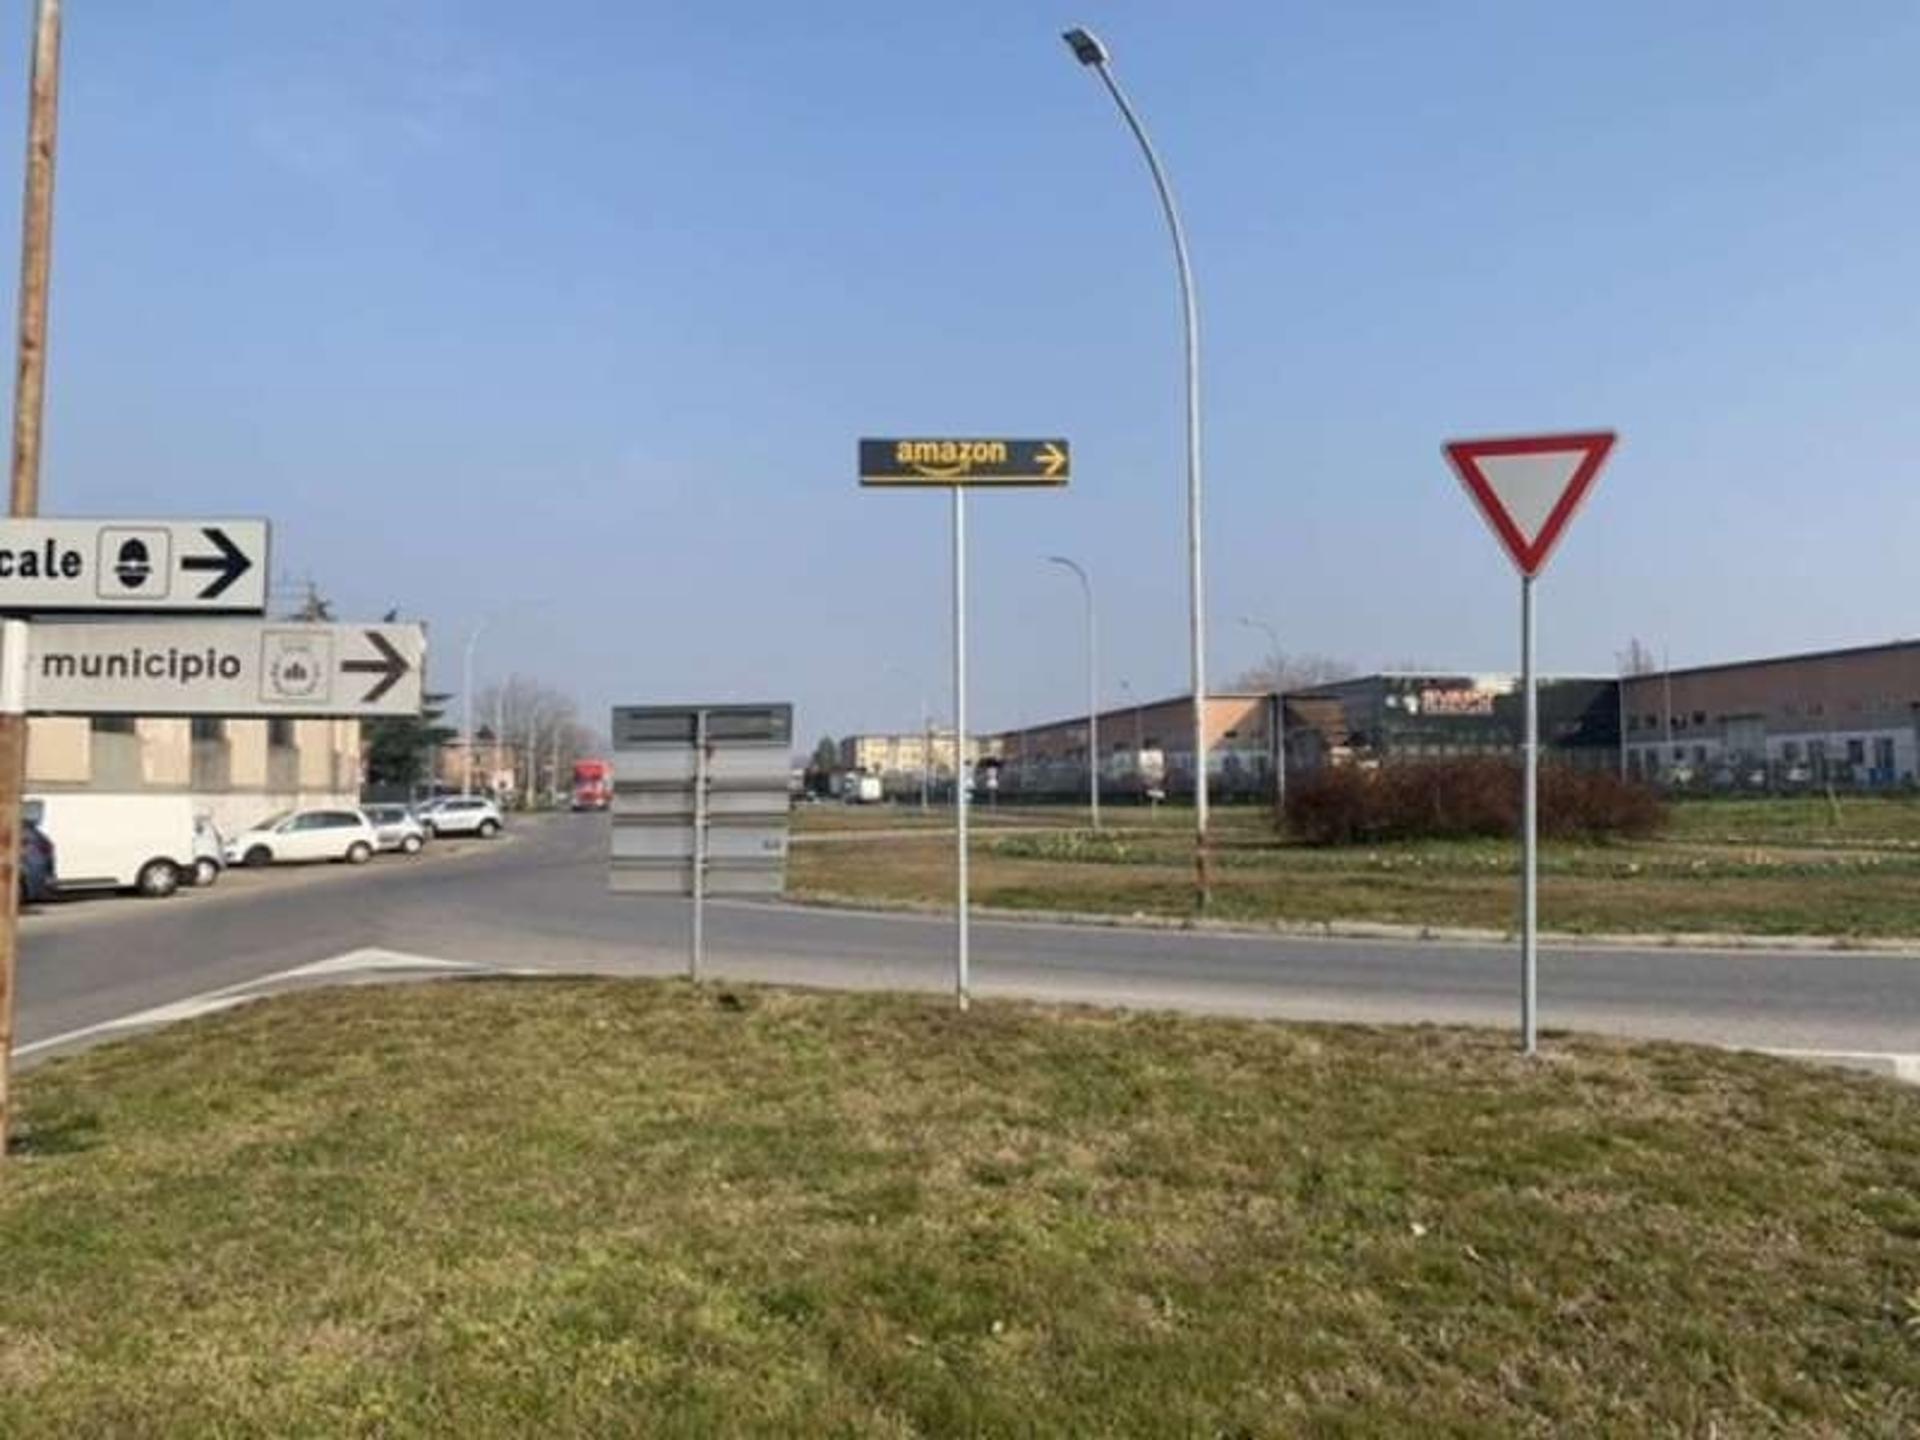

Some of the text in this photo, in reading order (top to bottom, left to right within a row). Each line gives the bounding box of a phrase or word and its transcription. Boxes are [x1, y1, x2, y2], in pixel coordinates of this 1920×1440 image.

[897, 441, 1006, 463] amazon
[0, 538, 82, 579] cale
[42, 648, 241, 684] municipio
